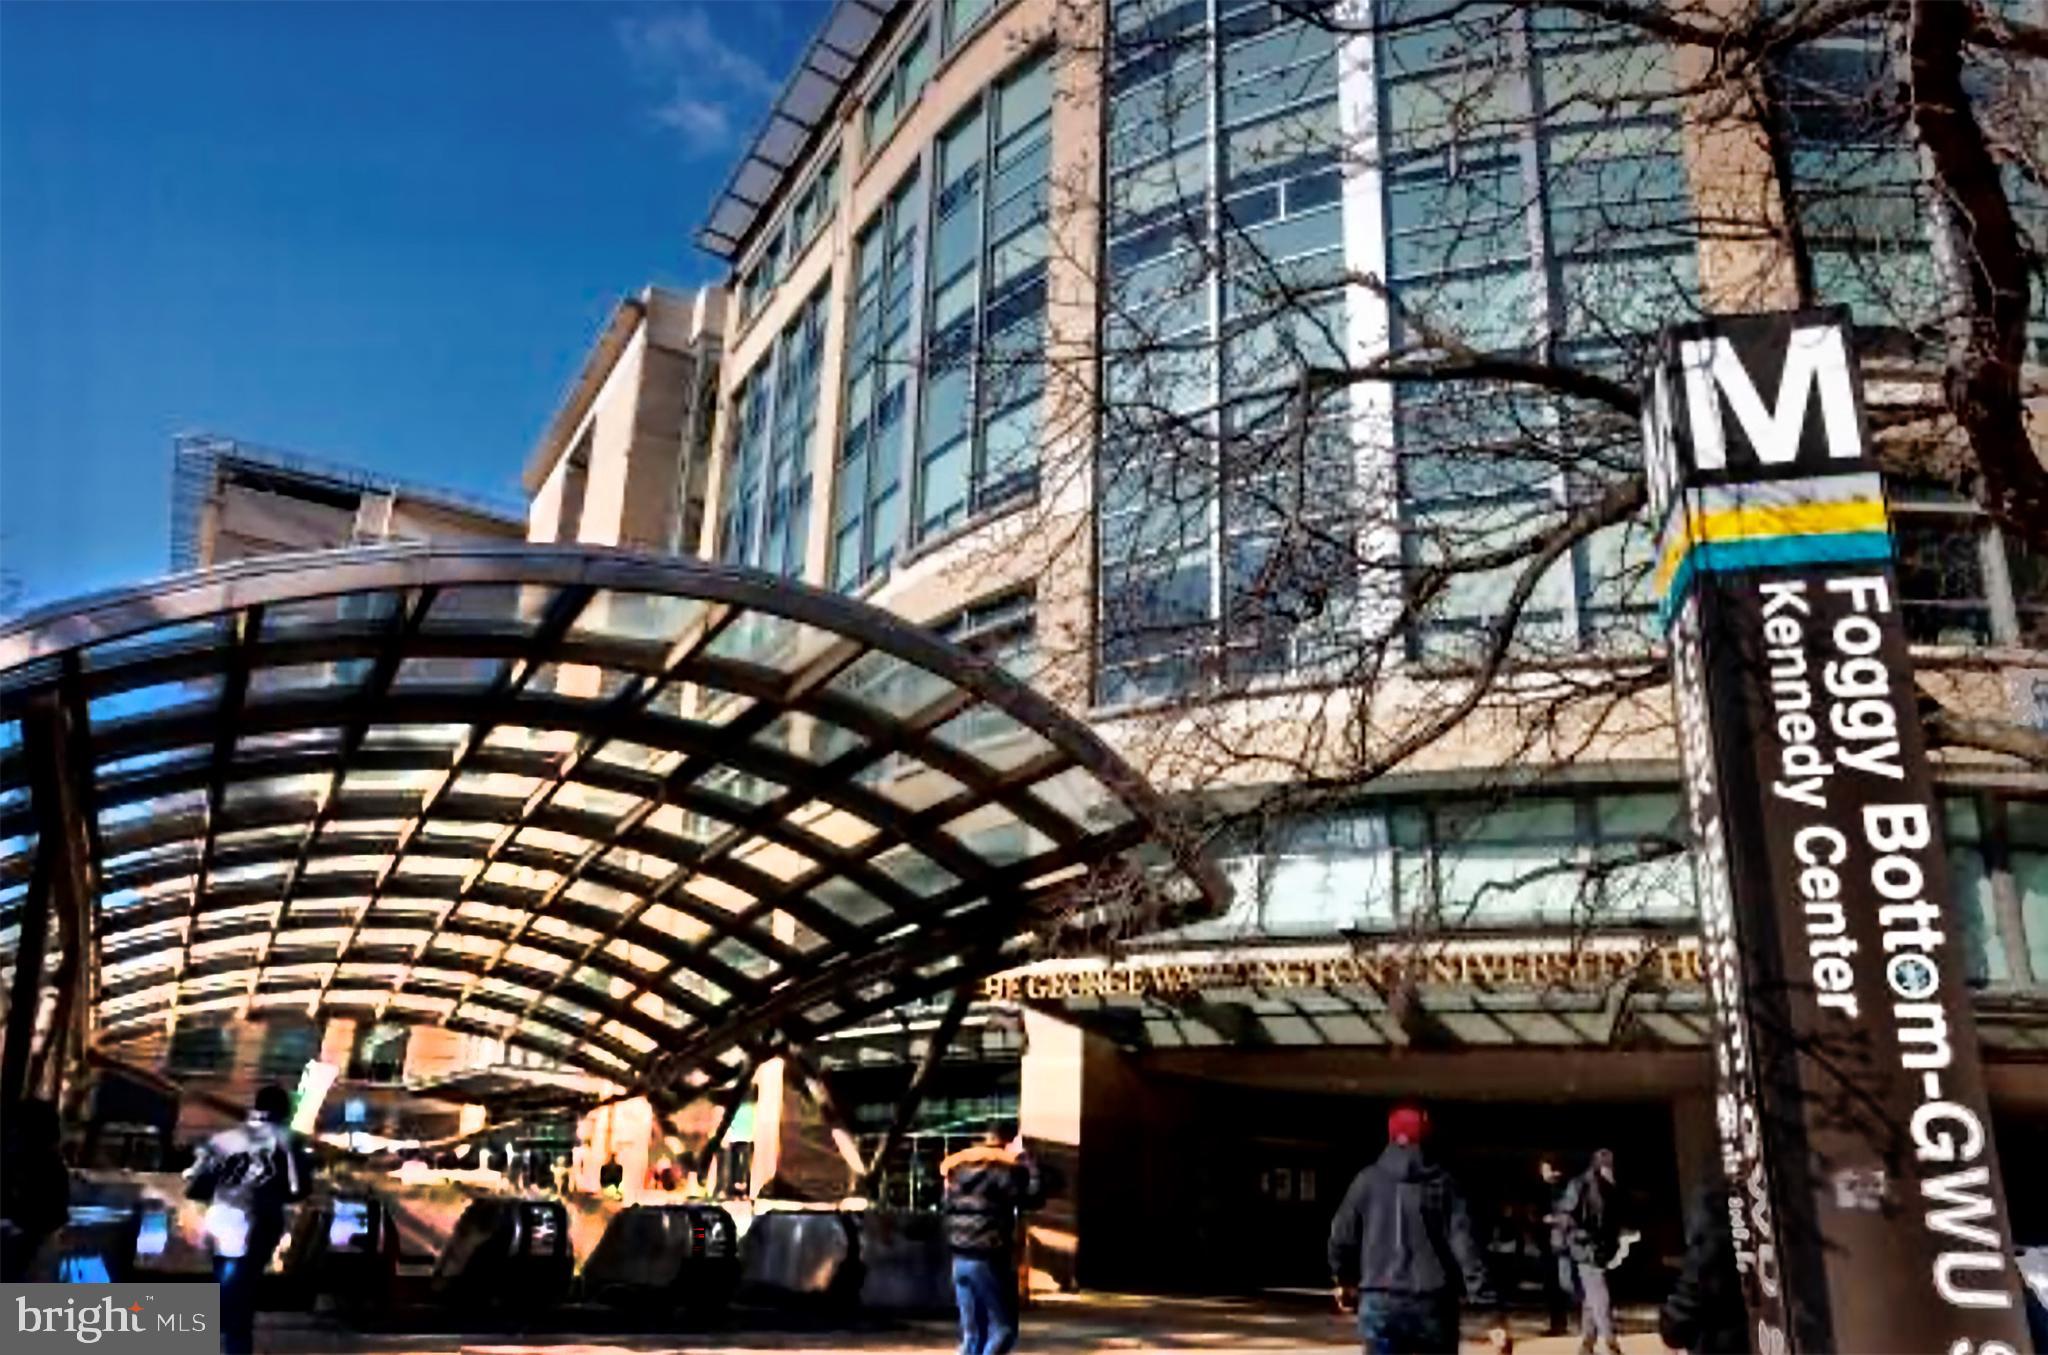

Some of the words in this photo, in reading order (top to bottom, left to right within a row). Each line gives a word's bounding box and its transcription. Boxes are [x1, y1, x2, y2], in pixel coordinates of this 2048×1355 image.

[1681, 325, 1862, 470] M
[1759, 579, 1834, 809] Kennedy
[1824, 576, 1904, 780] Foggy
[1794, 826, 1861, 1018] Center
[1862, 803, 2013, 1308] Bottom-GWU
